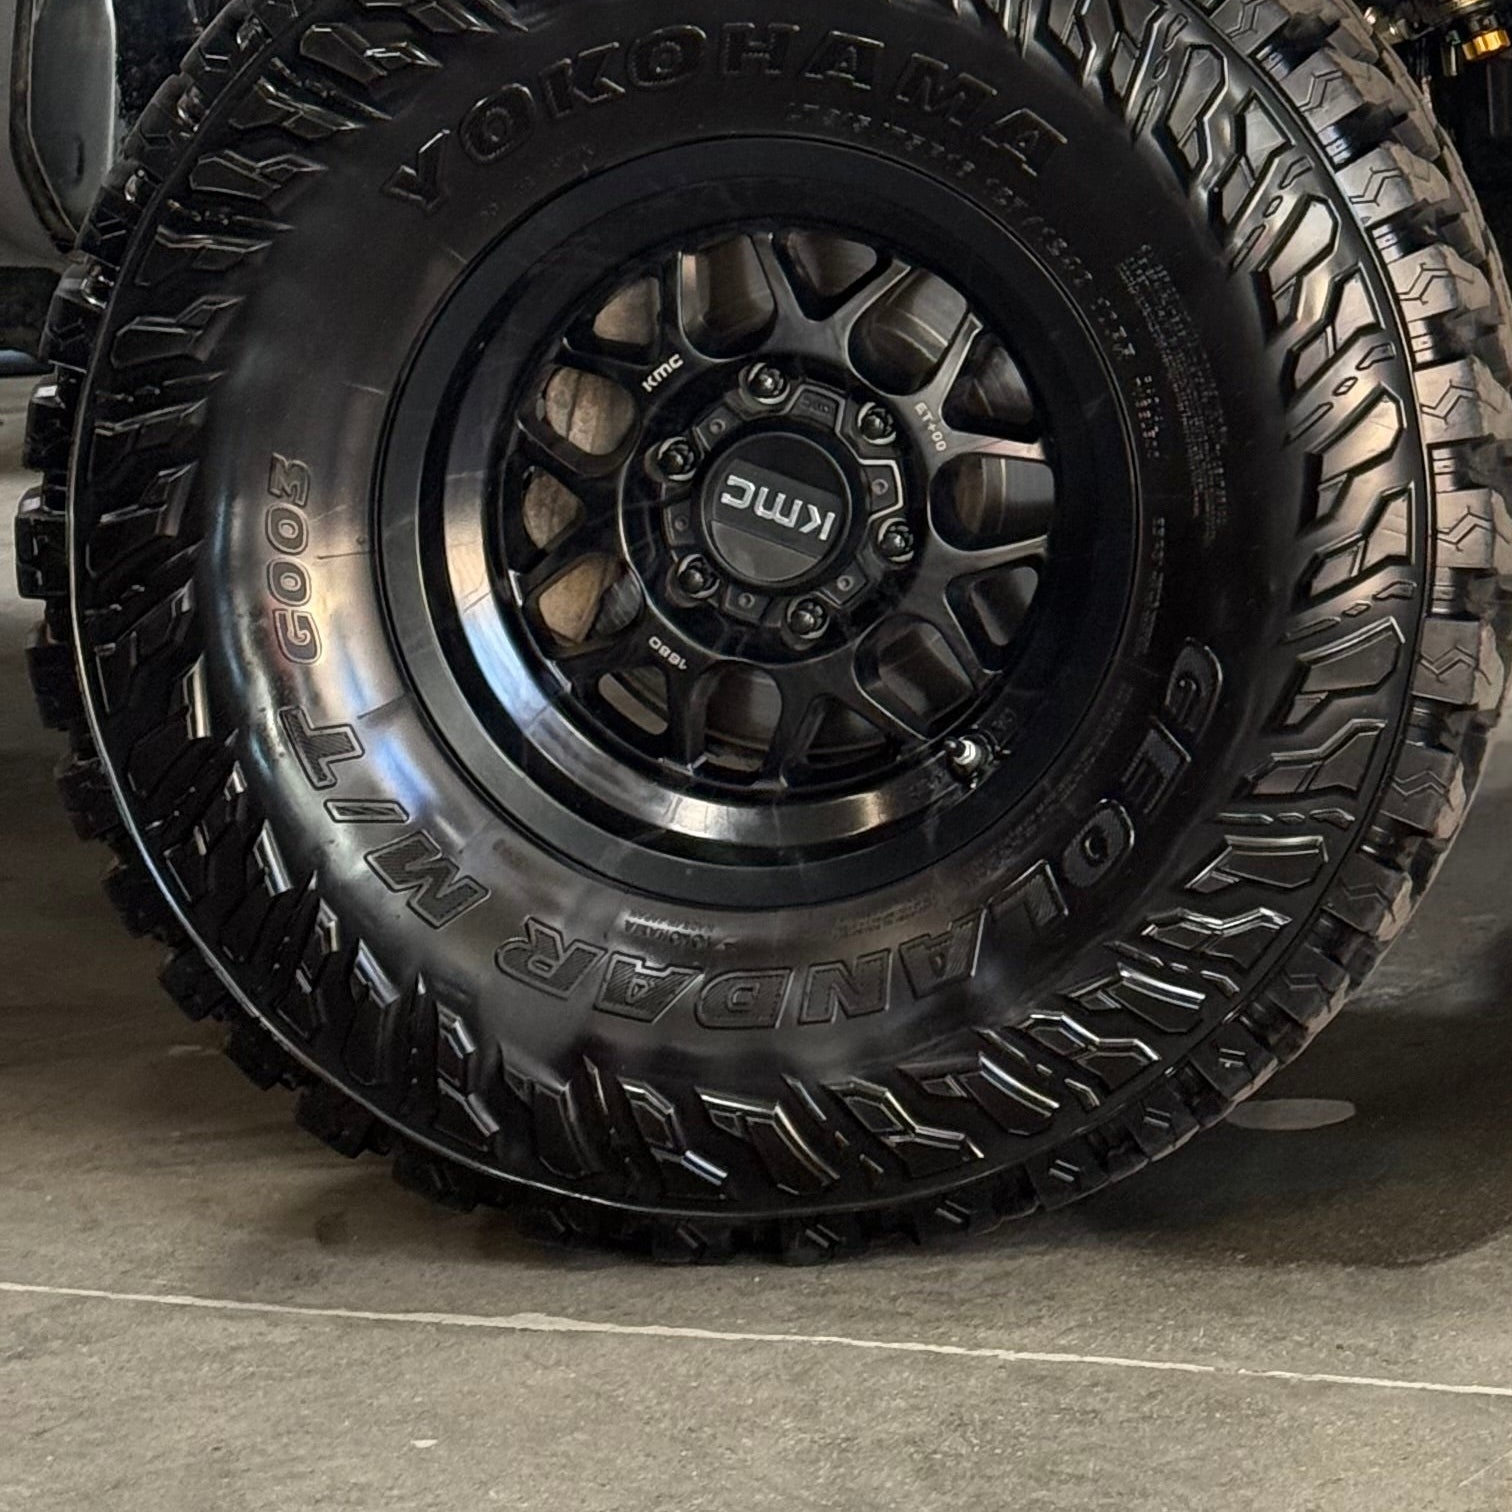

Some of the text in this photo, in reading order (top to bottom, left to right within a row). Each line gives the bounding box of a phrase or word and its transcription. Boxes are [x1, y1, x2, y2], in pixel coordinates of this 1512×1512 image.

[380, 20, 1070, 212] YOKOHAMA
[641, 353, 685, 394] KMC
[913, 402, 948, 452] ET+00
[265, 452, 323, 666] G003
[719, 473, 837, 542] KMC
[495, 637, 1223, 1029] GEOLANDAR
